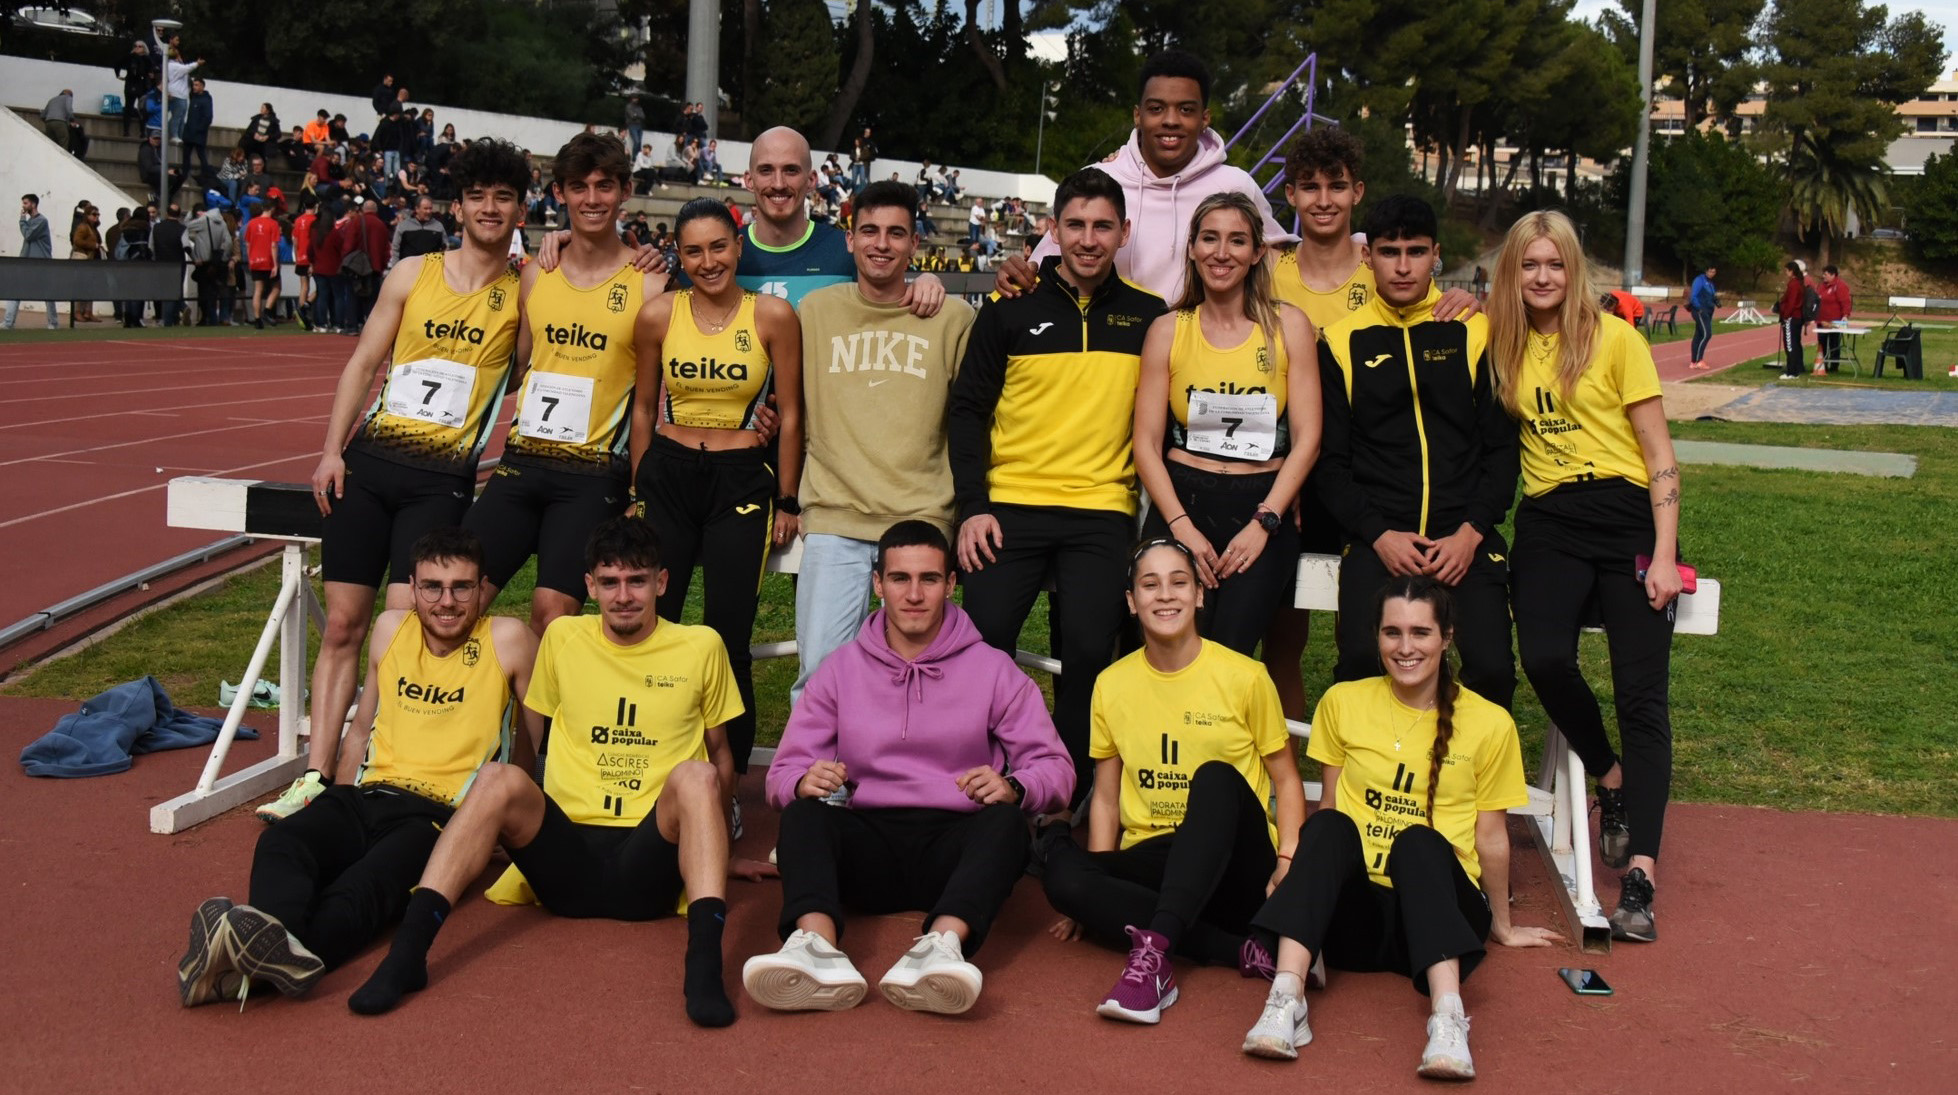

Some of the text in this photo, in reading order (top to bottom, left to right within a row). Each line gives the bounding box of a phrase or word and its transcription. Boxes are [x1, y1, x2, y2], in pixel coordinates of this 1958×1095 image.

[424, 319, 485, 345] teika
[545, 323, 608, 351] teika
[828, 330, 929, 380] NIKE
[669, 357, 748, 381] teika
[421, 379, 442, 405] 7
[684, 385, 704, 393] BUEN
[706, 383, 740, 393] VENDING
[541, 395, 560, 422] 7
[1221, 417, 1243, 438] 7
[1539, 418, 1566, 427] caixa
[669, 675, 688, 683] Safor
[397, 676, 465, 705] teika
[403, 705, 421, 715] BUEN
[422, 705, 455, 716] VENDING
[1195, 711, 1206, 719] CA
[612, 728, 642, 738] caixa
[611, 736, 658, 747] popular
[602, 768, 641, 777] PALOMINO
[1157, 771, 1188, 781] caixa
[1157, 779, 1192, 791] popul
[1152, 801, 1187, 809] MORATA
[1385, 795, 1417, 807] caixa
[1152, 808, 1186, 816] PALOMIN
[1384, 803, 1426, 818] popula
[1366, 822, 1400, 840] teik
